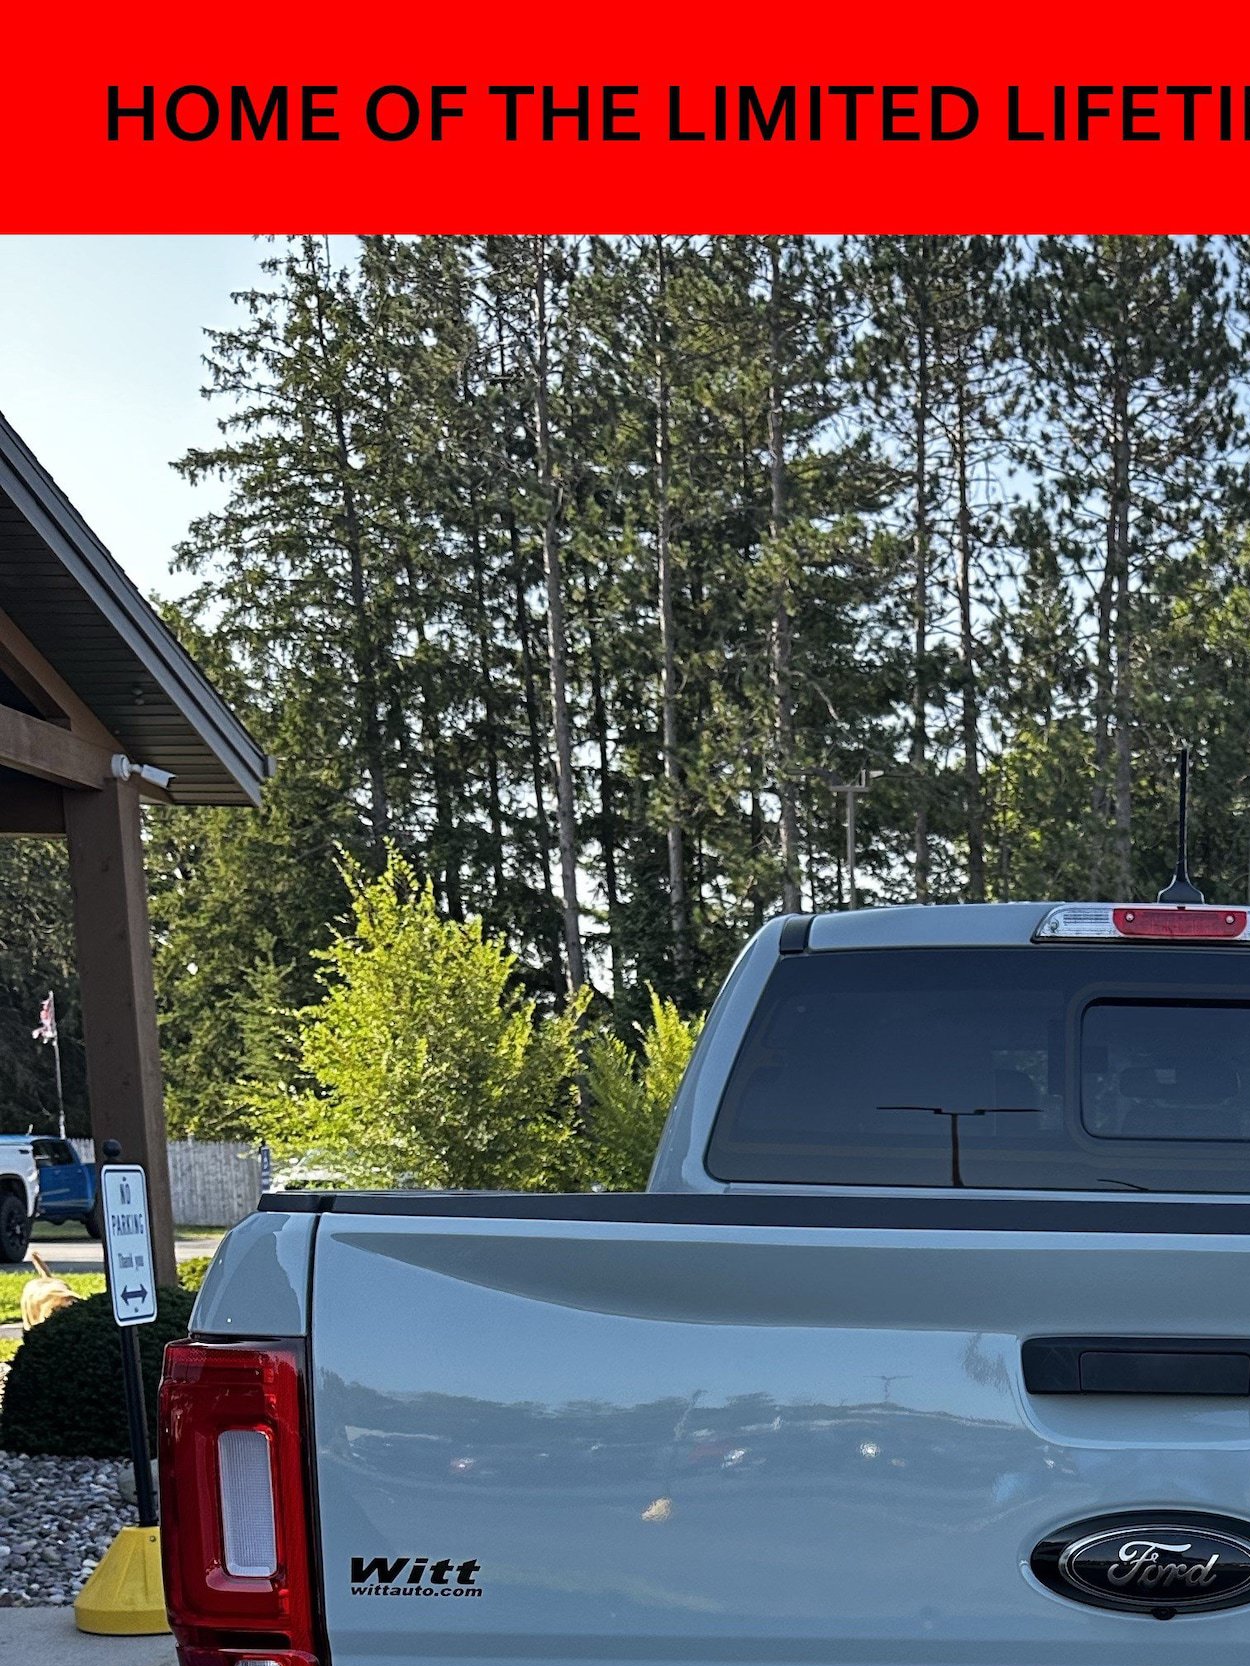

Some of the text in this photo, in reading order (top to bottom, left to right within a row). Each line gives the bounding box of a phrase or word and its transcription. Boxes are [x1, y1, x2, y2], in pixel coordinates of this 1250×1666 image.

[119, 1183, 131, 1205] NO
[111, 1213, 144, 1236] PARKING
[350, 1557, 482, 1585] Witt
[1107, 1540, 1220, 1587] Ford
[350, 1584, 483, 1597] wittauto.com
